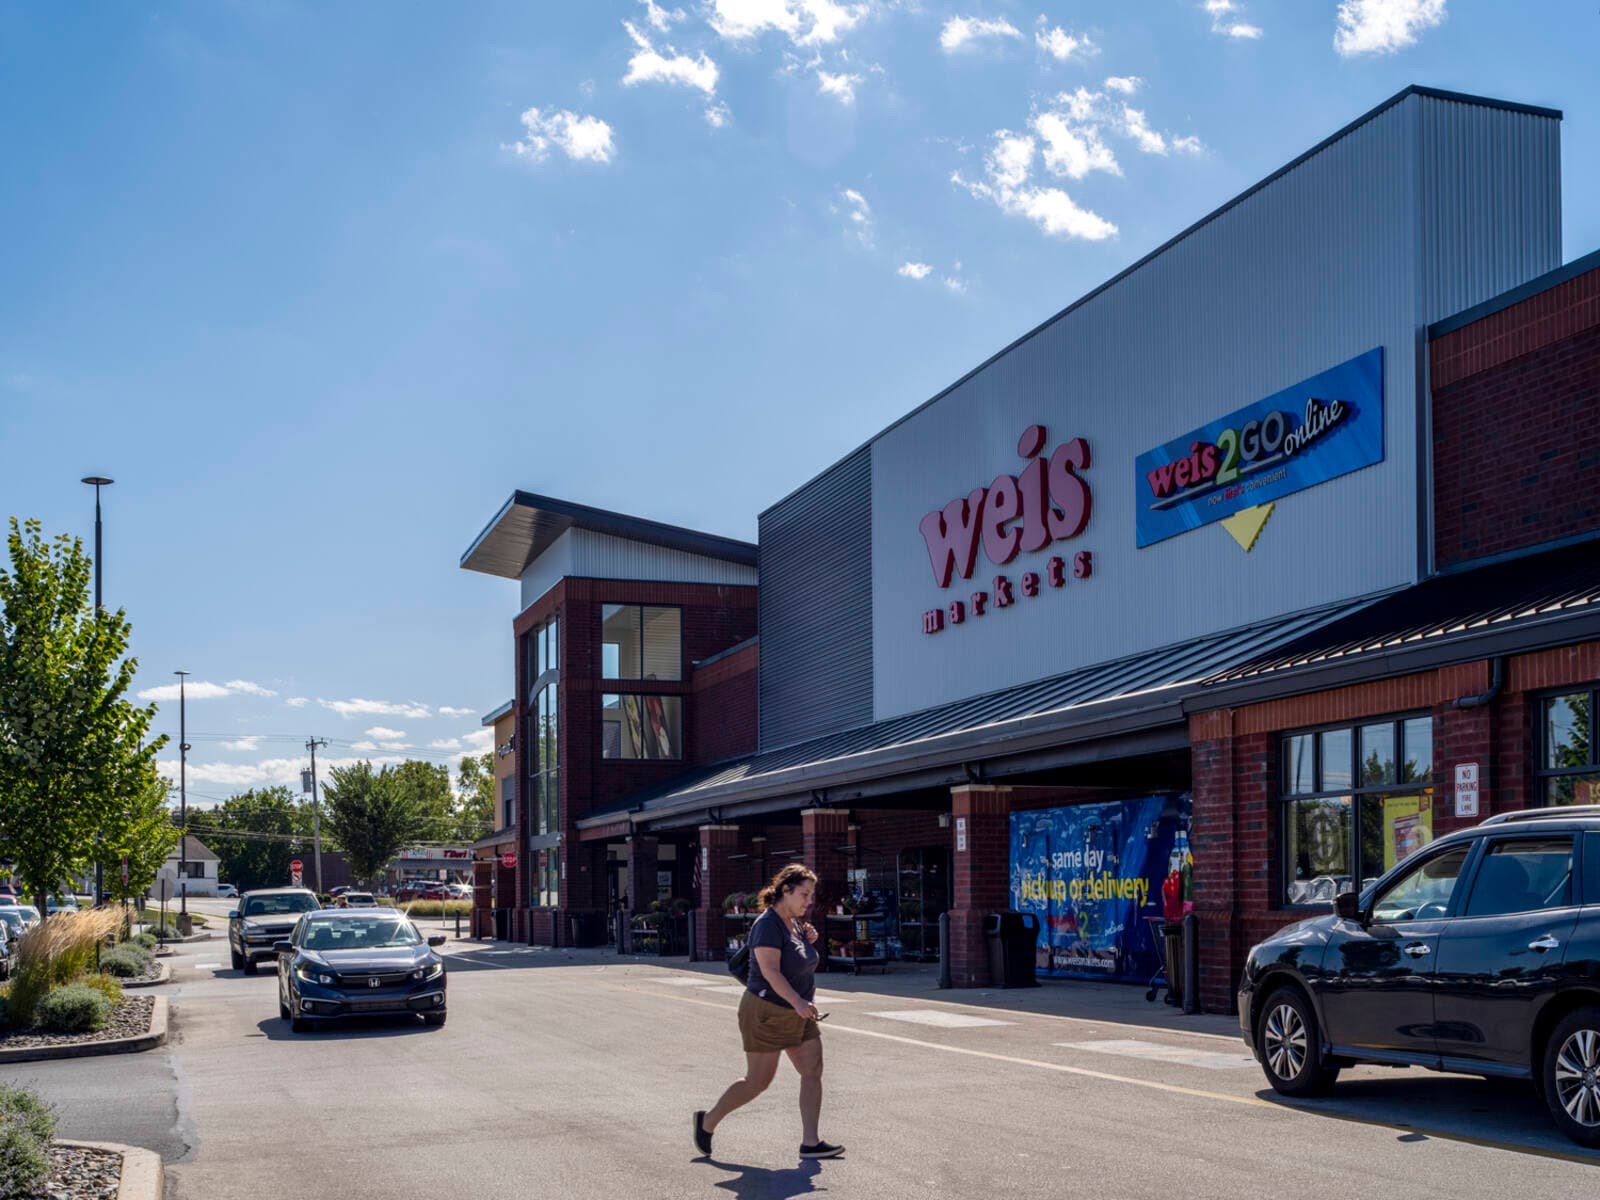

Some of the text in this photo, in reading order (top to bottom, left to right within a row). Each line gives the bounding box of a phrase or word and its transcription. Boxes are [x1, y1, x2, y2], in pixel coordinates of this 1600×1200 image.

[1284, 398, 1344, 455] online
[1245, 468, 1287, 492] convenient
[919, 424, 1092, 588] weis
[922, 551, 1093, 634] markets
[1462, 769, 1471, 780] NO
[1052, 844, 1104, 873] same day
[1070, 880, 1085, 899] or
[1086, 870, 1149, 908] delivery
